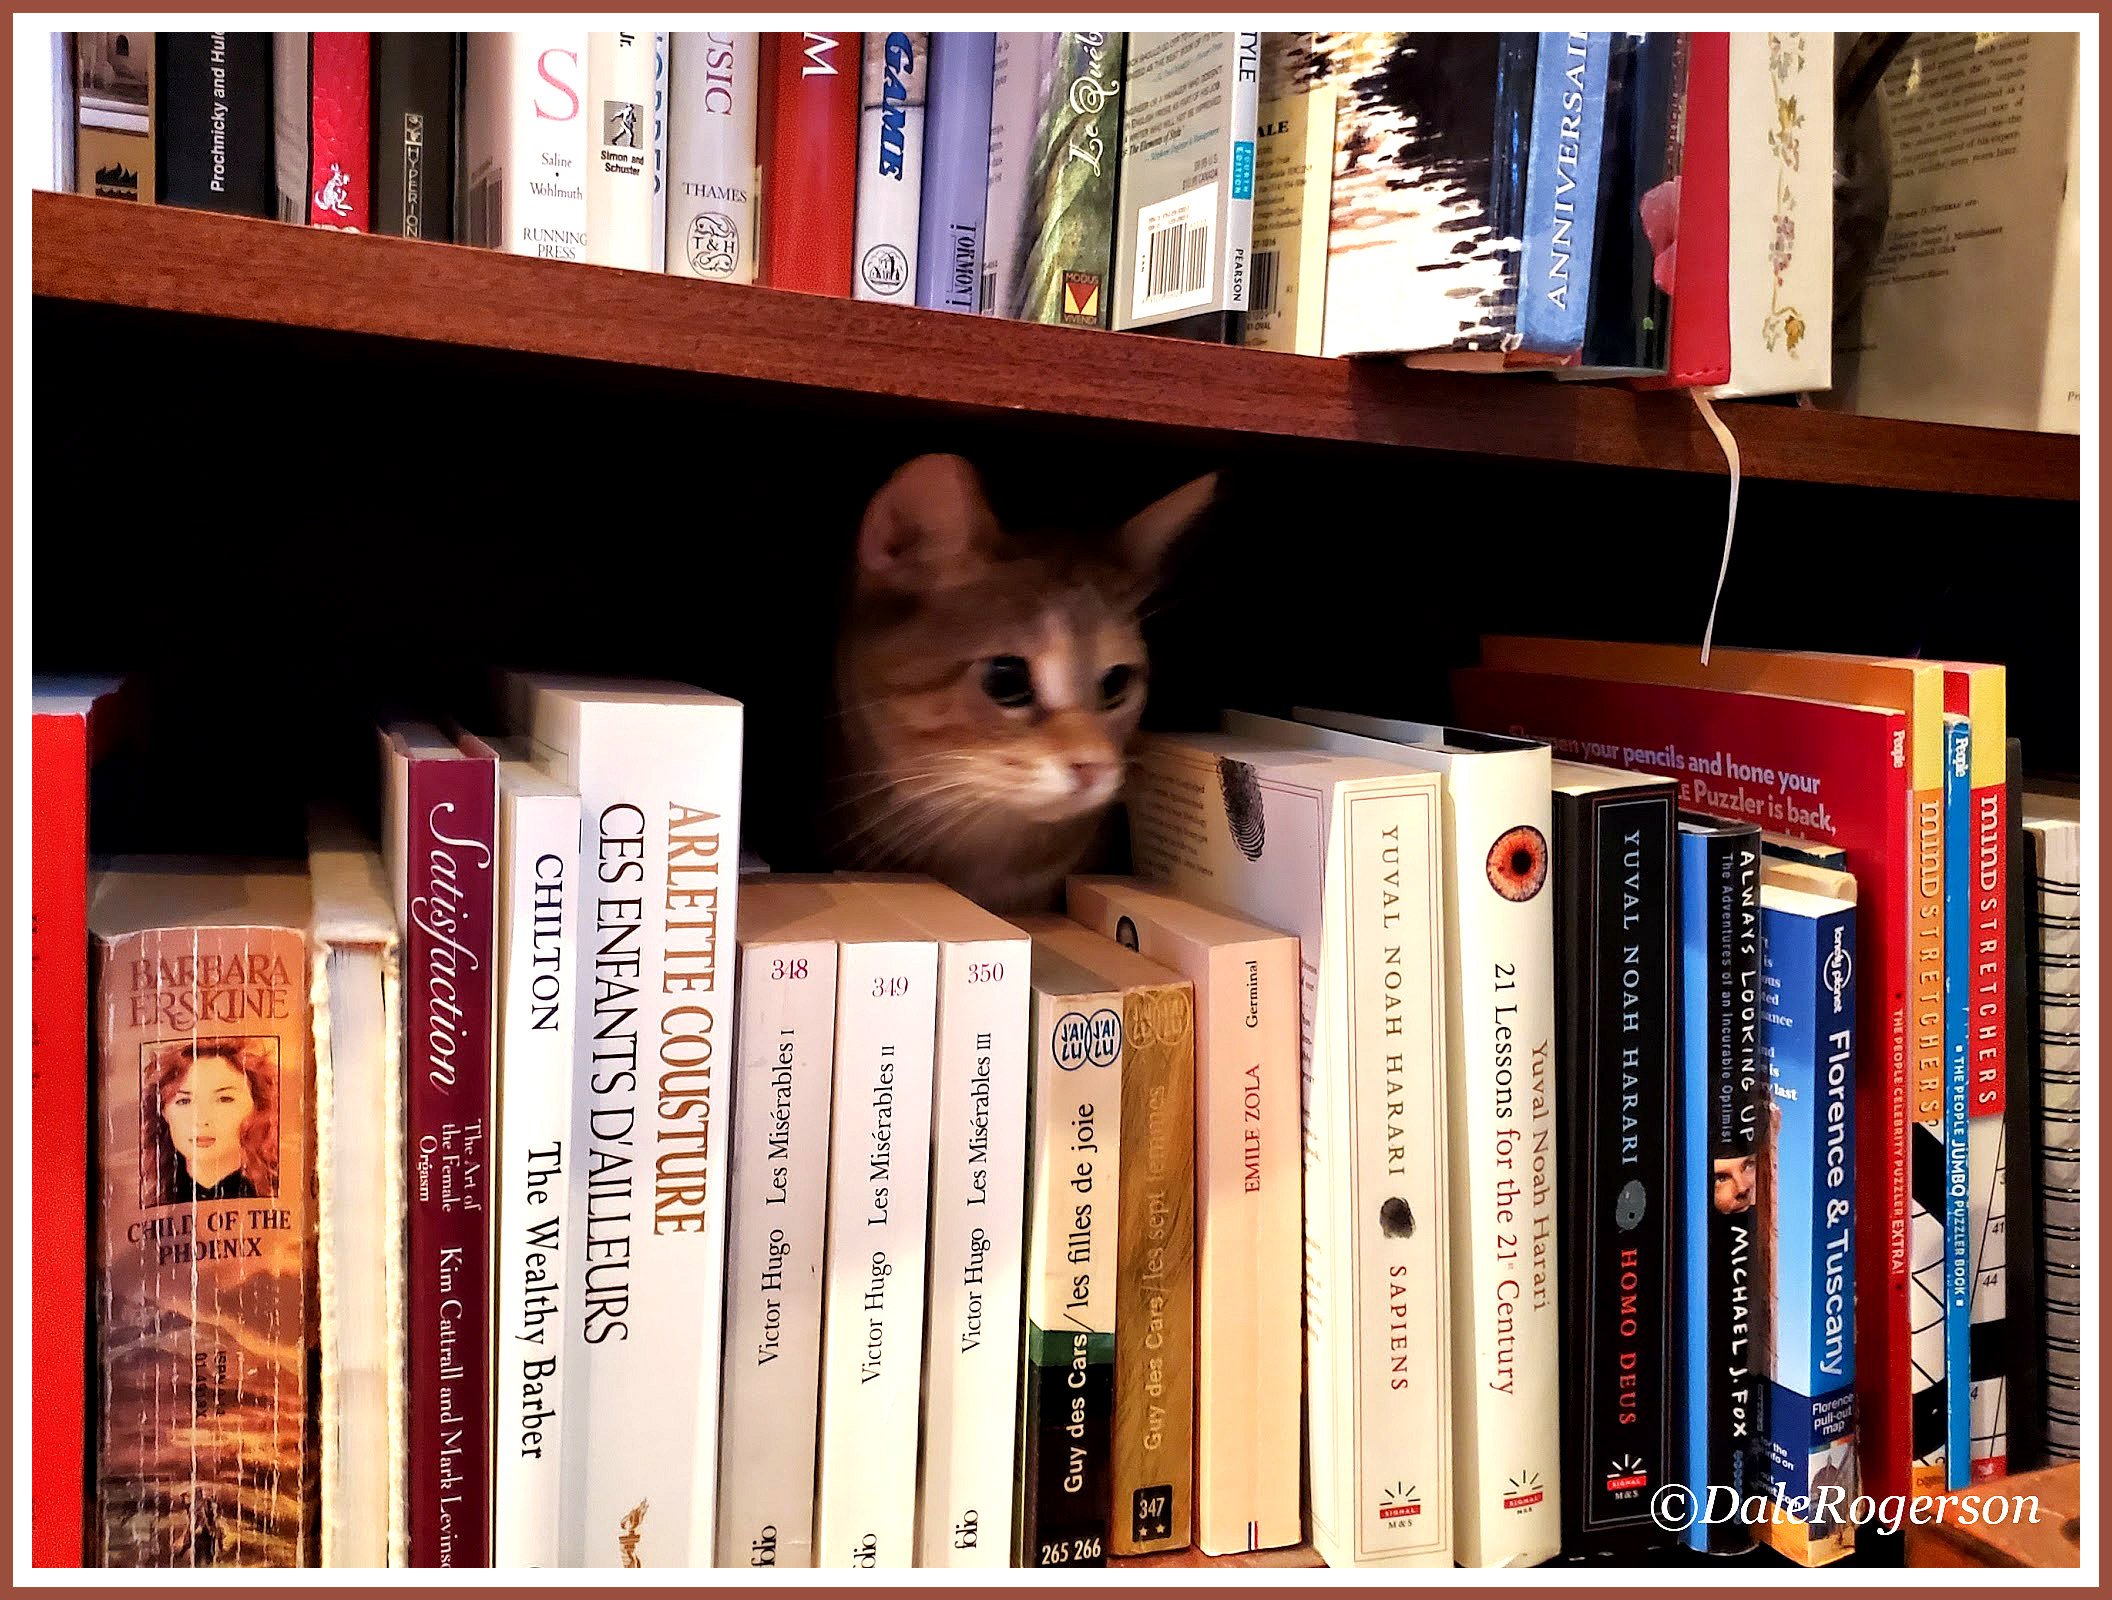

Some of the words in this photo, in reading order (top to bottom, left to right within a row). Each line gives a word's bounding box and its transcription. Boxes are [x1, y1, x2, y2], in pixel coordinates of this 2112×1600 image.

[211, 67, 226, 98] and
[879, 32, 915, 181] GAME
[210, 101, 228, 192] Prochnicky
[541, 152, 573, 168] Saline
[600, 150, 628, 163] Simon
[631, 155, 645, 166] and
[604, 162, 640, 176] Schuster
[1069, 122, 1103, 178] Le
[406, 146, 418, 237] HYPERION
[529, 181, 584, 201] Wohlmuth
[682, 182, 748, 203] THAMES
[523, 227, 588, 247] RUNNING
[537, 244, 576, 260] PRESS
[1065, 272, 1099, 285] MODUS
[1233, 248, 1244, 302] PEARSON
[1580, 741, 1619, 765] your
[1623, 743, 1686, 772] pencils
[1688, 751, 1723, 777] and
[1725, 751, 1775, 786] hone
[1777, 768, 1822, 796] your
[1892, 729, 1906, 769] People
[1955, 736, 1970, 778] People
[1693, 779, 1766, 816] Puzzler
[1767, 795, 1784, 820] is
[1786, 797, 1838, 835] back,
[597, 802, 646, 885] CES
[1721, 853, 1733, 879] The
[661, 800, 722, 995] ARLETTE
[1381, 824, 1400, 930] YUVAL
[1623, 829, 1641, 931] YUVAL
[1740, 850, 1756, 955] ALWAYS
[411, 802, 492, 1097] Satisfaction
[531, 853, 565, 1032] CHILTON
[1721, 885, 1733, 966] Adventures
[130, 953, 291, 992] BARBARA
[590, 896, 644, 1095] ENFANTS
[770, 958, 809, 980] 348
[871, 975, 910, 998] 349
[967, 962, 1005, 984] 350
[1245, 959, 1258, 1029] Germinal
[1384, 946, 1403, 1037] NOAH
[1494, 963, 1516, 993] 21
[1622, 944, 1641, 1034] NOAH
[1721, 972, 1732, 987] of
[130, 987, 290, 1032] ERSKINE
[1721, 991, 1732, 1008] an
[1893, 1008, 1904, 1033] THE
[1919, 904, 1941, 1113] STRETCHERS
[1978, 898, 1999, 1106] STRETCHERS
[1721, 1013, 1733, 1079] Incurable
[1741, 970, 1757, 1093] LOOKING
[1494, 1004, 1518, 1119] Lessons
[1531, 1039, 1550, 1120] Yuval
[1893, 1036, 1904, 1085] PEOPLE
[1953, 1055, 1965, 1082] THE
[767, 1041, 795, 1161] Misérables
[968, 1055, 991, 1165] Misérables
[1246, 1064, 1261, 1122] ZOLA
[1386, 1054, 1406, 1176] HARARI
[1621, 1046, 1640, 1166] HARARI
[1719, 1084, 1733, 1144] Optimist
[1774, 1083, 1798, 1101] last
[1827, 1029, 1850, 1189] Florence
[1953, 1085, 1965, 1136] PEOPLE
[441, 1121, 462, 1147] the
[464, 1117, 483, 1155] The
[652, 1004, 716, 1237] COUSTURE
[870, 1063, 895, 1181] Misérables
[1071, 1102, 1098, 1153] joie
[1739, 1104, 1756, 1143] UP
[1893, 1087, 1904, 1157] CELEBRITY
[414, 1135, 438, 1203] Orgasm
[464, 1162, 481, 1188] Art
[527, 1140, 563, 1206] The
[1245, 1128, 1260, 1195] EMILE
[1496, 1128, 1521, 1170] for
[1532, 1127, 1551, 1208] Noah
[1951, 1138, 1967, 1198] JUMBO
[442, 1152, 461, 1214] Female
[464, 1193, 482, 1211] of
[765, 1165, 788, 1206] Les
[867, 1186, 888, 1226] Les
[966, 1171, 986, 1207] Les
[1070, 1162, 1094, 1194] de
[1496, 1178, 1522, 1224] the
[1893, 1160, 1904, 1216] PUZZLER
[206, 1209, 239, 1234] OF
[247, 1207, 292, 1232] THE
[582, 1105, 637, 1345] D'AILLEURS
[1067, 1204, 1092, 1265] filles
[1826, 1198, 1849, 1229] &
[1953, 1199, 1966, 1256] PUZZLER
[439, 1246, 464, 1294] Kim
[761, 1228, 791, 1292] Hugo
[963, 1226, 991, 1286] Hugo
[1533, 1215, 1552, 1312] Harari
[1891, 1218, 1905, 1275] EXTRA!
[514, 1215, 561, 1346] Wealthy
[864, 1251, 892, 1312] Hugo
[1620, 1247, 1638, 1338] HOMO
[1730, 1226, 1748, 1357] MICHAEL
[1819, 1228, 1850, 1376] Tuscany
[1954, 1258, 1966, 1296] BOOK
[1982, 1273, 1998, 1287] 44
[439, 1299, 464, 1381] Cattrall
[757, 1298, 782, 1367] Victor
[961, 1290, 983, 1355] Victor
[1389, 1265, 1408, 1391] SAPIENS
[1489, 1279, 1521, 1396] Century
[861, 1317, 883, 1385] Victor
[1145, 1357, 1163, 1398] des
[1729, 1366, 1748, 1386] J.
[439, 1386, 464, 1426] and
[521, 1354, 557, 1460] Barber
[1618, 1352, 1637, 1425] DEUS
[1066, 1398, 1086, 1439] des
[1143, 1403, 1166, 1451] Guy
[1814, 1405, 1853, 1431] pull-out
[1822, 1419, 1846, 1436] map
[439, 1429, 464, 1491] Mark
[1063, 1445, 1089, 1494] Guy
[1773, 1442, 1788, 1458] the
[1782, 1458, 1795, 1471] on
[954, 1509, 979, 1550] folio
[1138, 1497, 1166, 1520] 347
[1041, 1540, 1070, 1566] 265
[1073, 1537, 1102, 1561] 266
